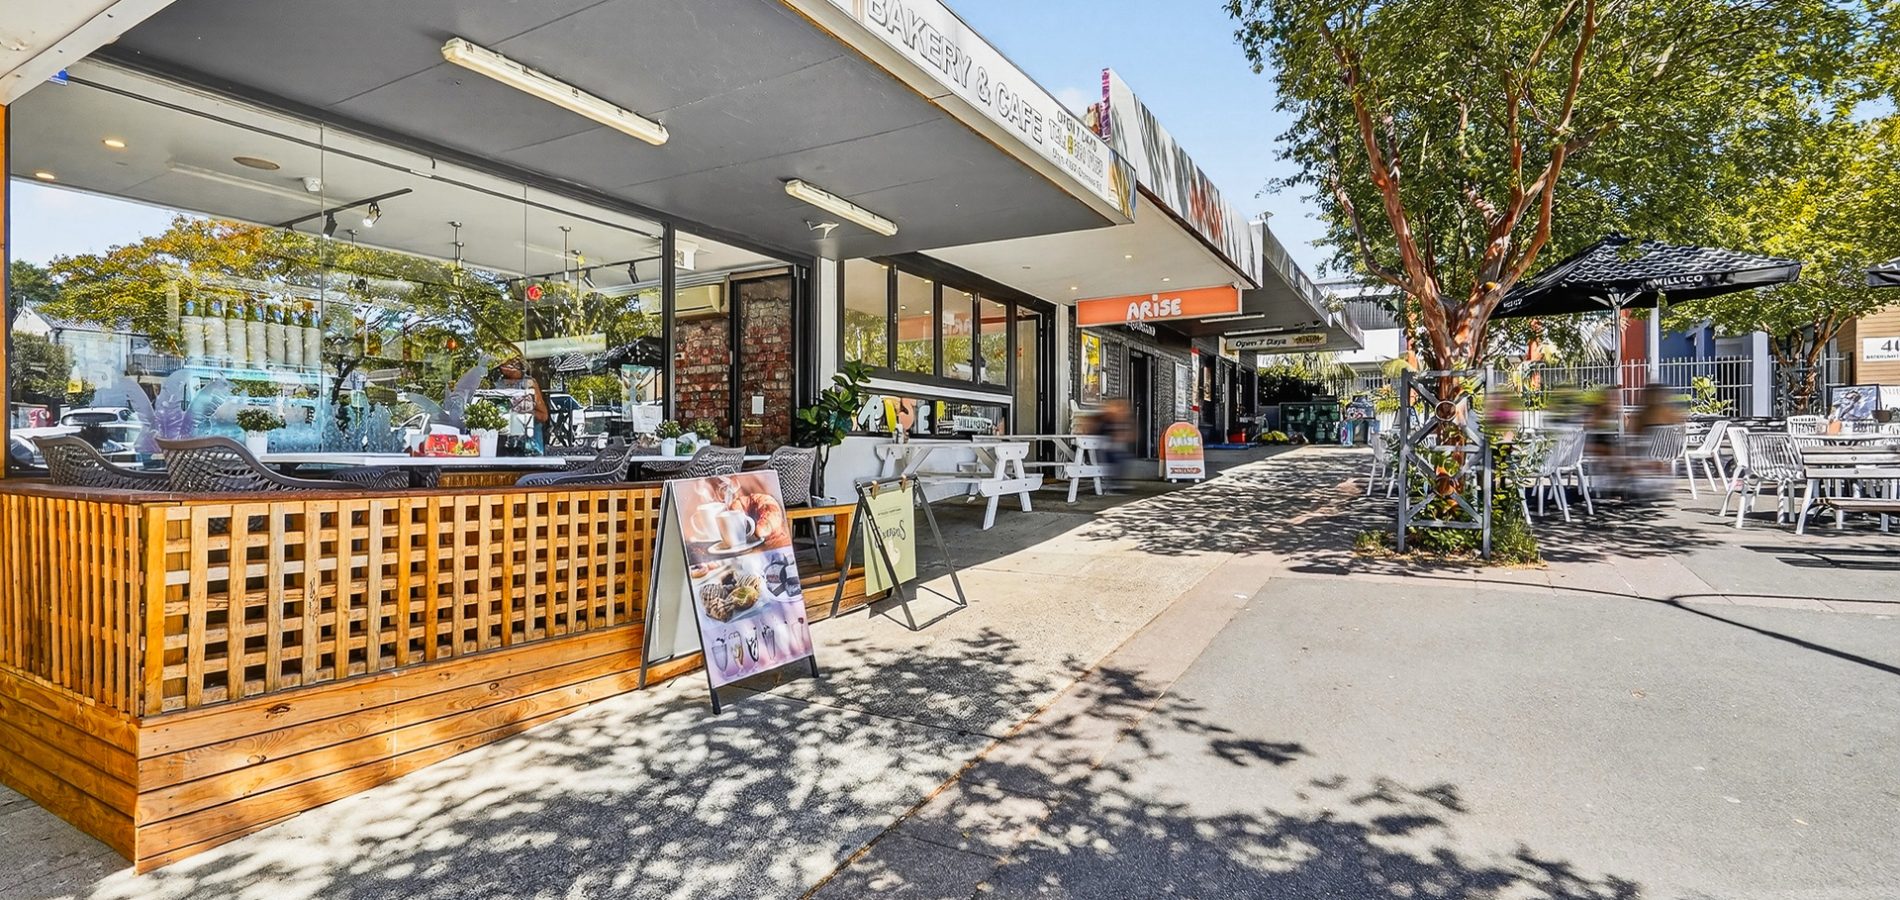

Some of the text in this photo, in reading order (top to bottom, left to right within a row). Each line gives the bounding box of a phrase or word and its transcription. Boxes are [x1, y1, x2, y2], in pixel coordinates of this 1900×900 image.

[867, 0, 1043, 144] BAKERY & CAFE
